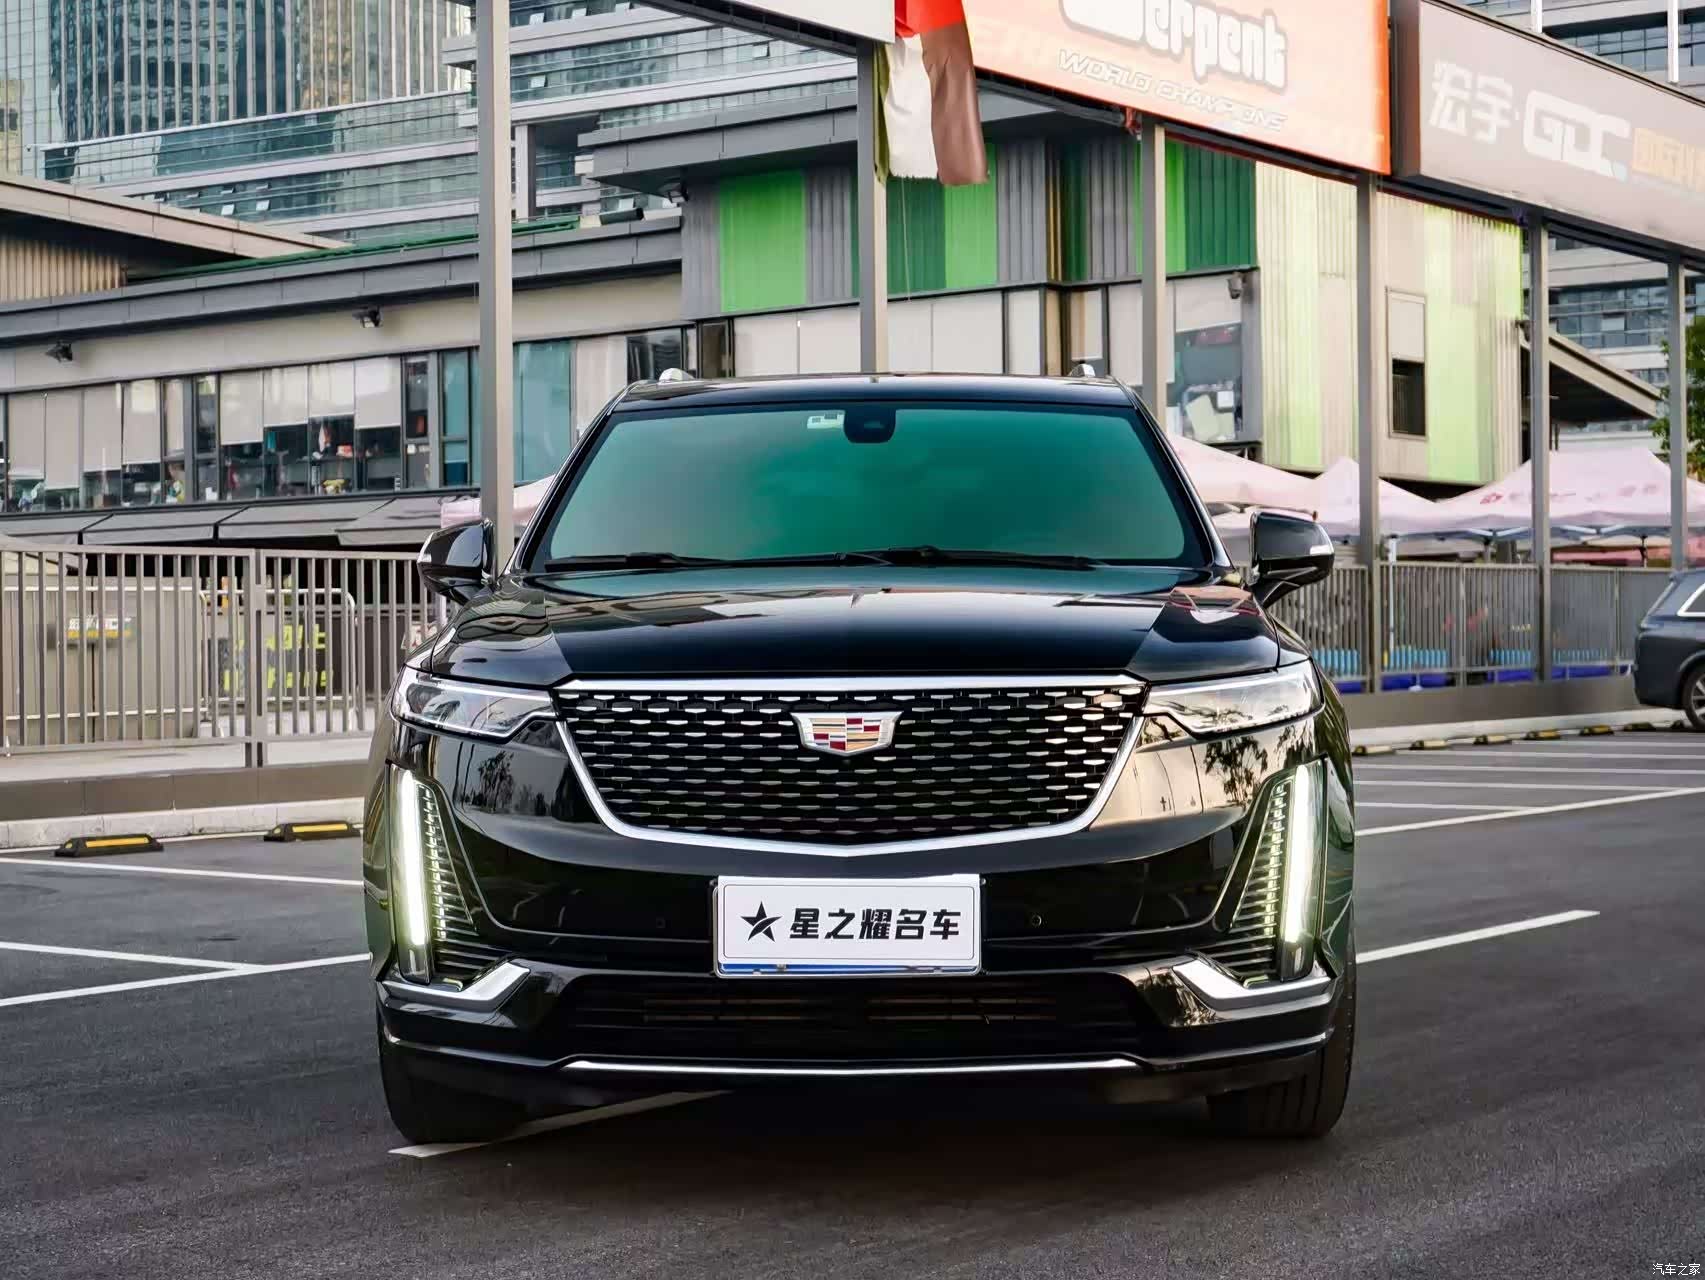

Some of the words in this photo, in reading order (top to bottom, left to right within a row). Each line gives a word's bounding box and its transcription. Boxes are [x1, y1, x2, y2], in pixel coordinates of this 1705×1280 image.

[1058, 49, 1152, 93] WORLD
[790, 907, 961, 941] 星之耀名车
